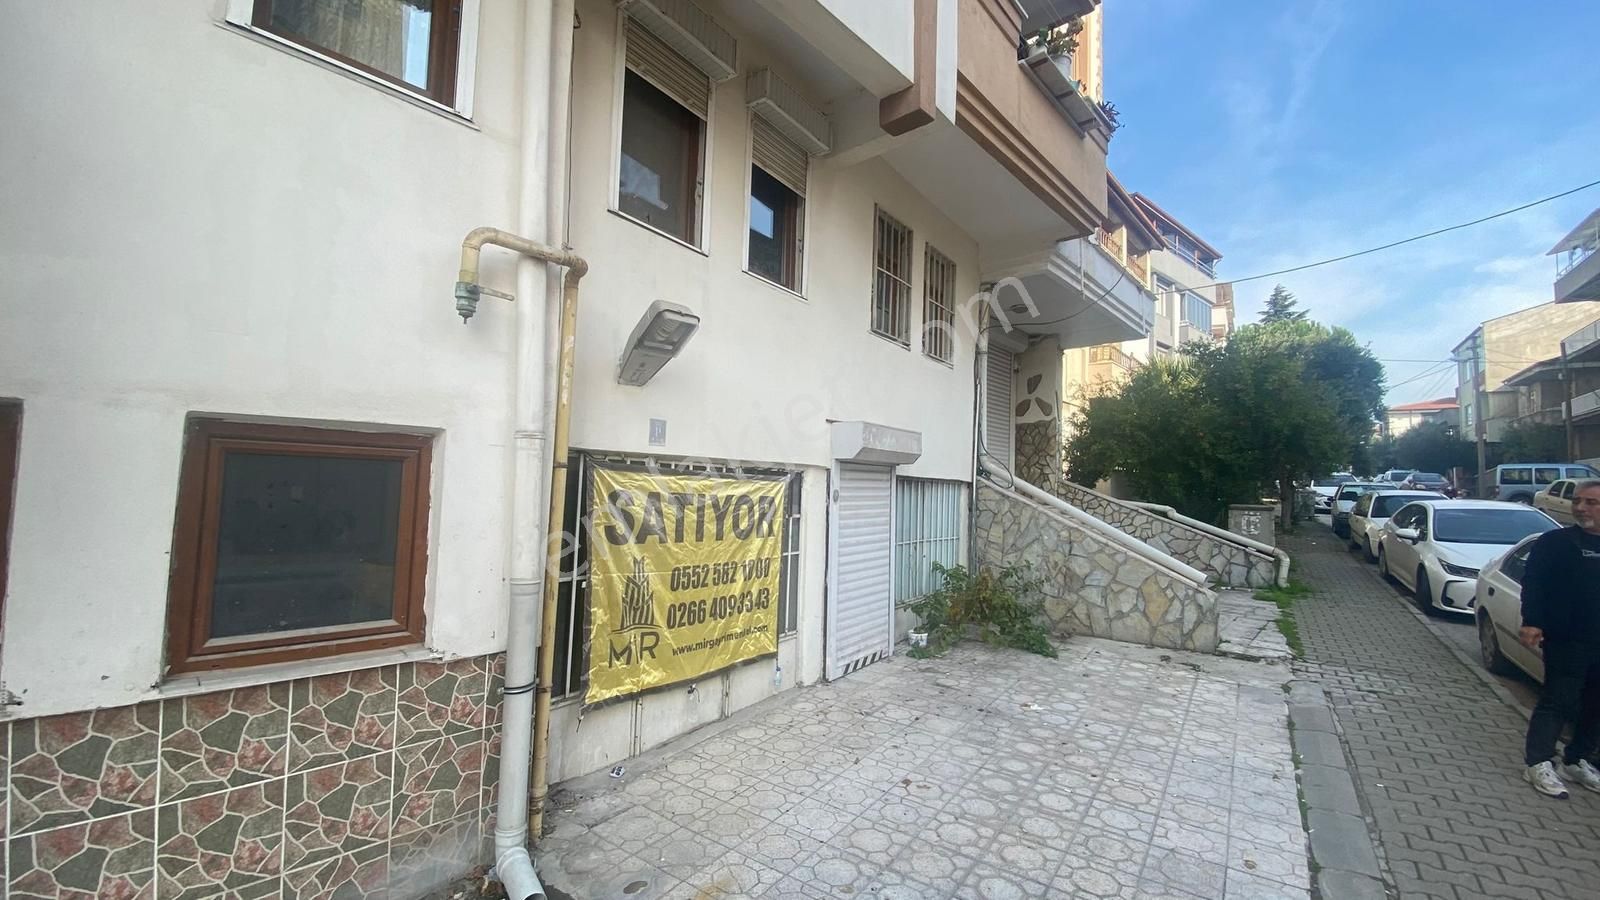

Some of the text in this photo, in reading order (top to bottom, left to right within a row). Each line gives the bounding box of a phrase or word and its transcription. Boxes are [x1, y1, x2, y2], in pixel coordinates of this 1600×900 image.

[604, 490, 776, 545] SATIYOR
[671, 564, 709, 591] 0552
[712, 561, 737, 586] 582
[666, 599, 706, 629] 0266
